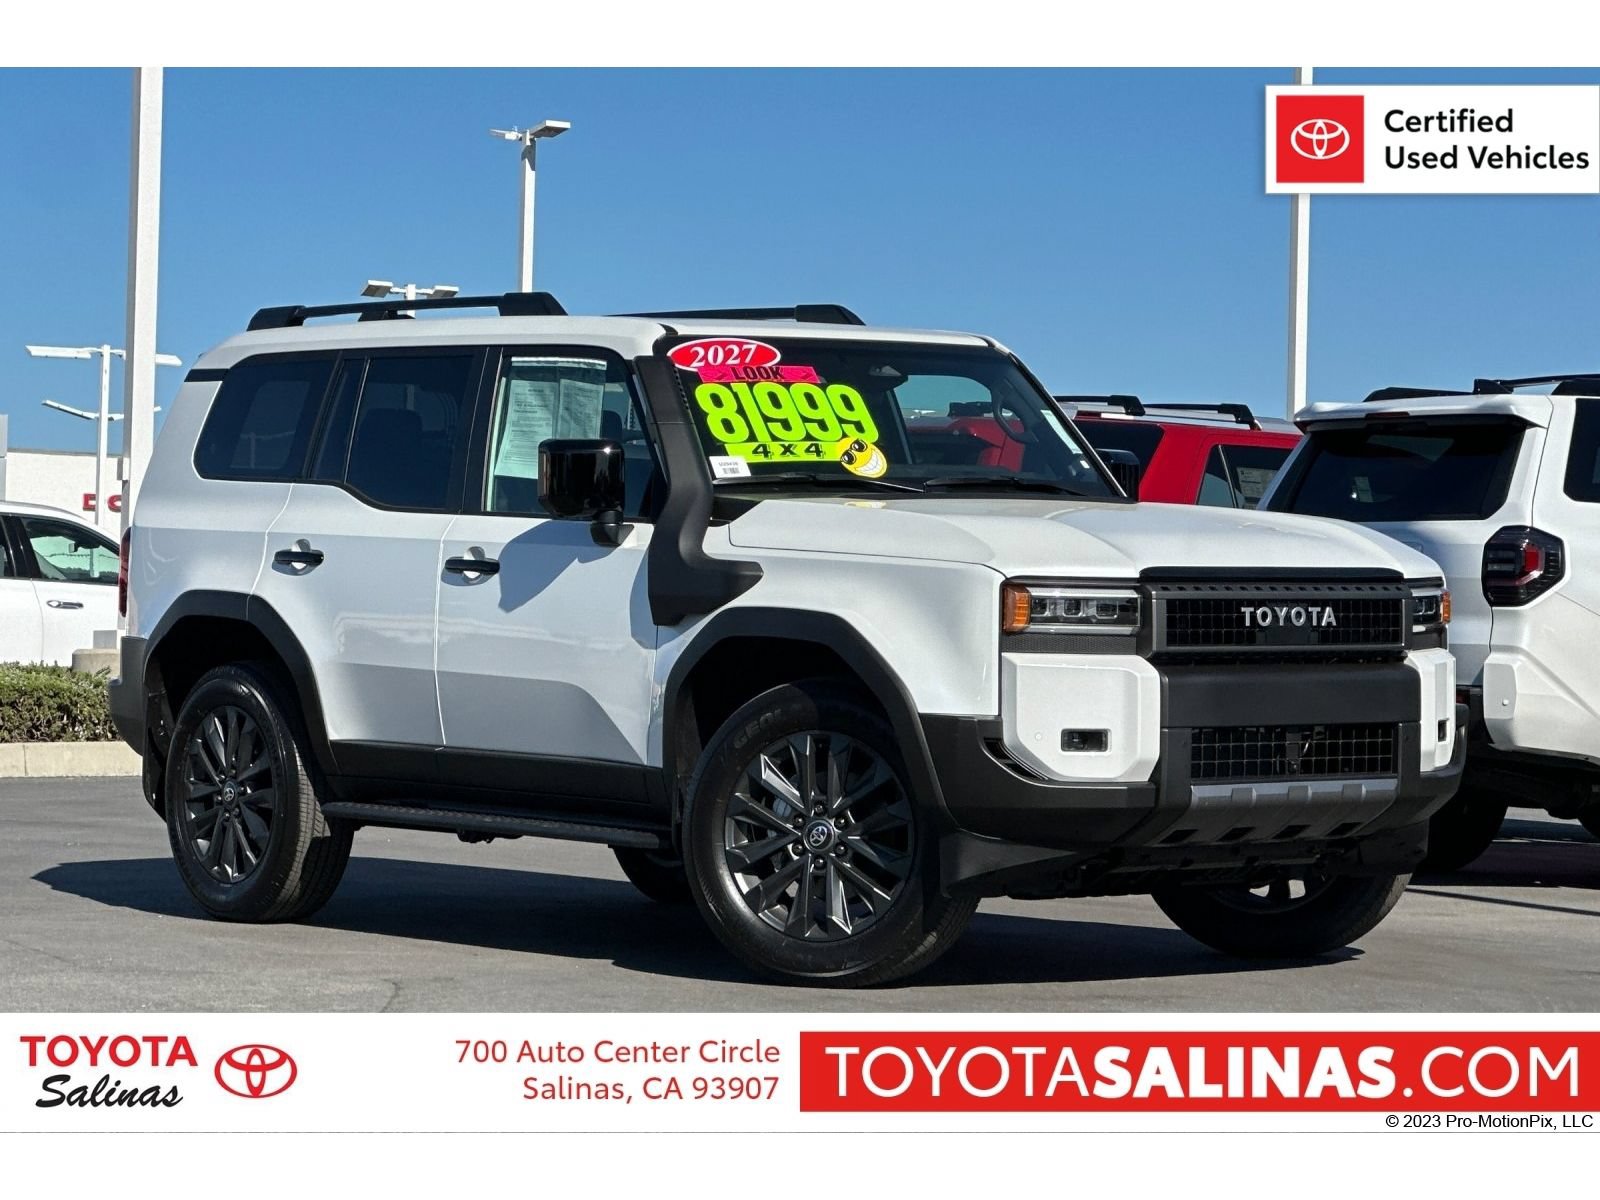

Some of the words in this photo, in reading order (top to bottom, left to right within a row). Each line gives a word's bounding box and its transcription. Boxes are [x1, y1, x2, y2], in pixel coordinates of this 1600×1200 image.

[689, 344, 758, 368] 2027
[730, 366, 786, 381] LOOK
[694, 382, 879, 443] 81999
[1241, 606, 1337, 626] TOYOTA
